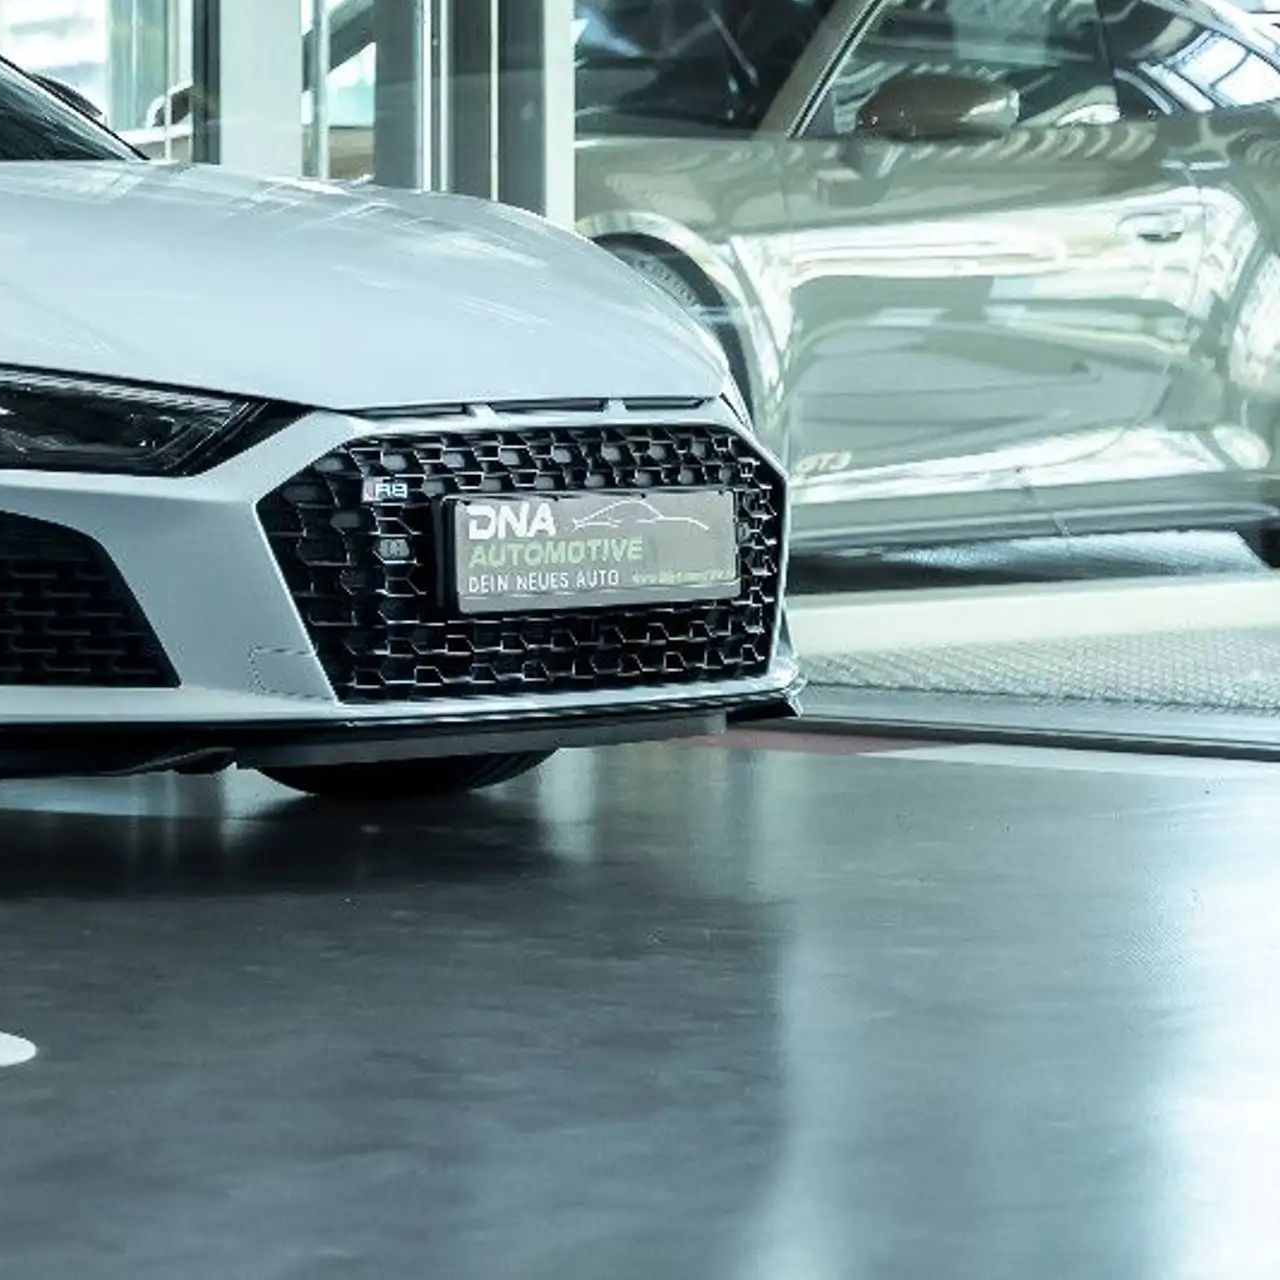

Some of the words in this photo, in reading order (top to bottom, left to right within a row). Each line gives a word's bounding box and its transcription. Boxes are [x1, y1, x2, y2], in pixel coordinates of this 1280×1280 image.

[374, 482, 408, 500] R8
[466, 501, 557, 540] DNA
[468, 537, 643, 569] AUTOMOTIVE
[468, 574, 509, 594] DEIN
[516, 571, 570, 591] NEUES
[576, 569, 620, 588] AUTO
